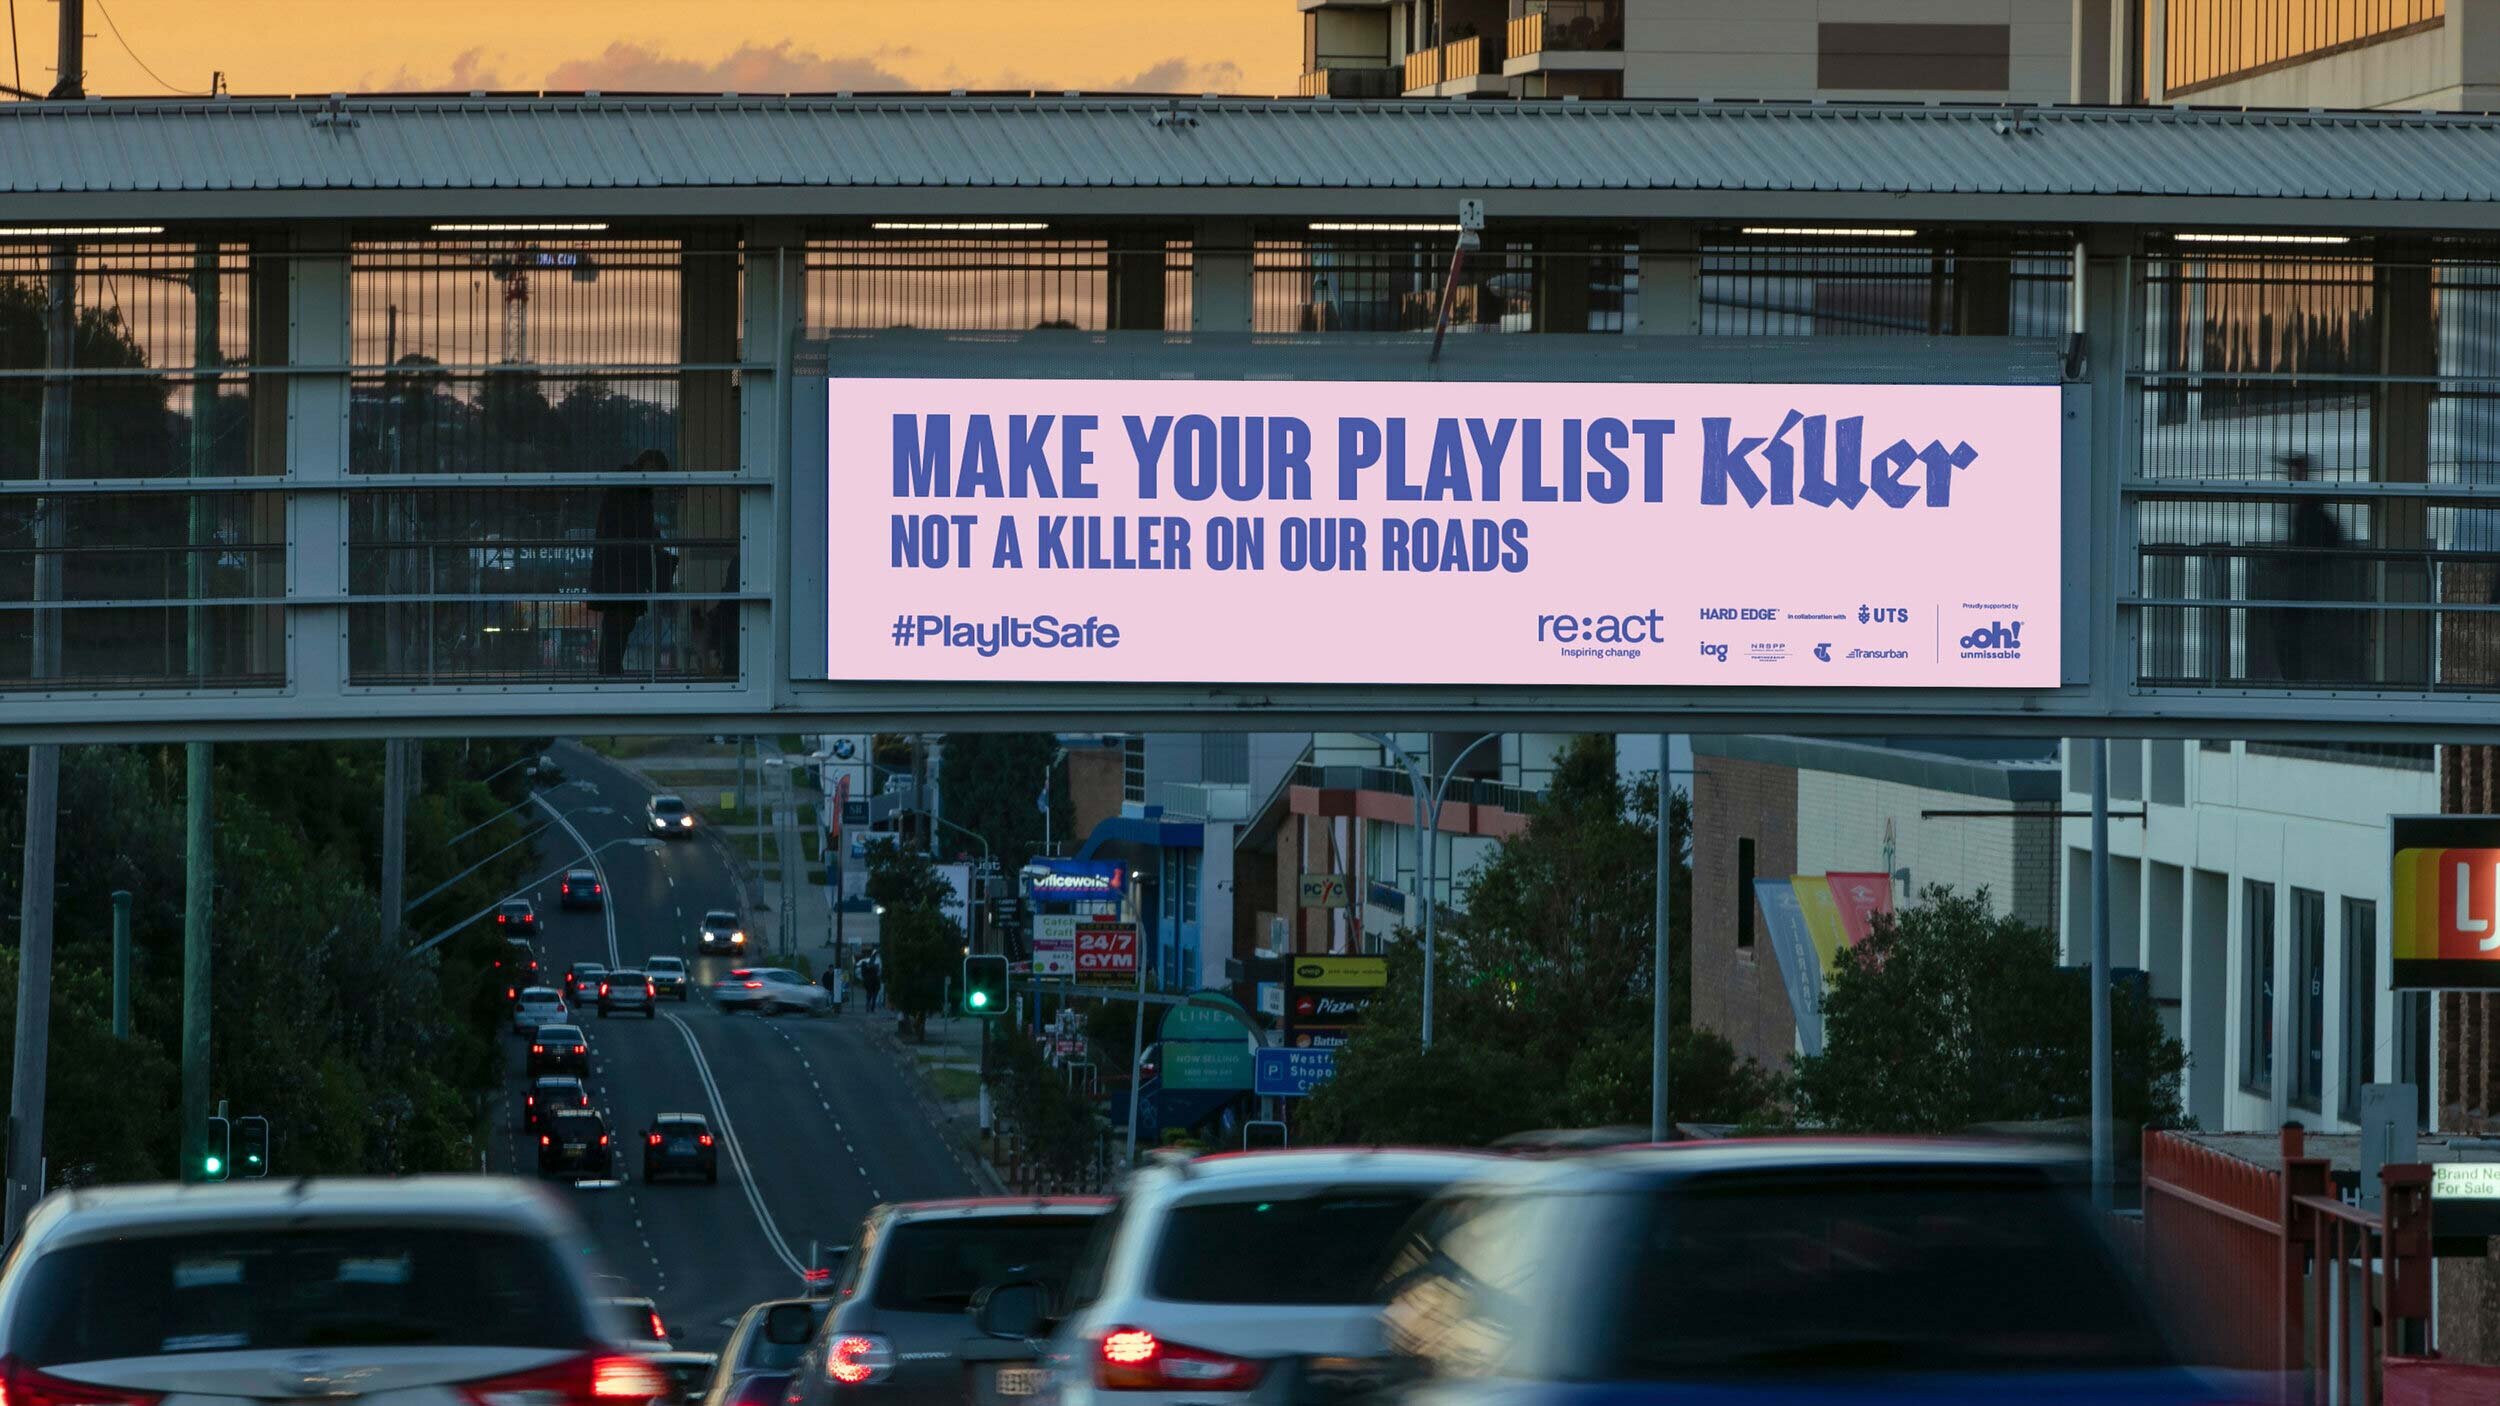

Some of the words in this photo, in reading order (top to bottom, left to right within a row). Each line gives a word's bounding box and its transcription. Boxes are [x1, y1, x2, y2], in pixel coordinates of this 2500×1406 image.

[893, 414, 1098, 498] MAKE
[1122, 414, 1312, 501] YOUR
[1339, 417, 1675, 504] PLAYLIST
[891, 514, 978, 569] NOT
[992, 515, 1023, 568] A
[1038, 515, 1191, 570] KILLER
[1206, 516, 1264, 571] ON
[1280, 517, 1366, 571] OUR
[1382, 518, 1528, 573] ROADS
[1700, 608, 1737, 620] HARD
[1874, 608, 1908, 623] UTS
[1538, 608, 1664, 643] re:act
[892, 614, 1120, 657] #PlayItSafe
[1562, 647, 1603, 659] Inspiring
[1605, 648, 1641, 659] change
[1700, 641, 1729, 662] iag
[1854, 648, 1908, 658] Transurban
[1961, 650, 2021, 659] unmissable
[1304, 879, 1343, 904] PCYC
[1080, 934, 1132, 951] 24/7
[1080, 953, 1133, 967] GYM
[1316, 998, 1354, 1014] Pizza
[1290, 1066, 1336, 1078] Shopp
[2437, 1167, 2478, 1180] Brand
[2437, 1182, 2460, 1194] For
[2465, 1182, 2494, 1194] Sale
